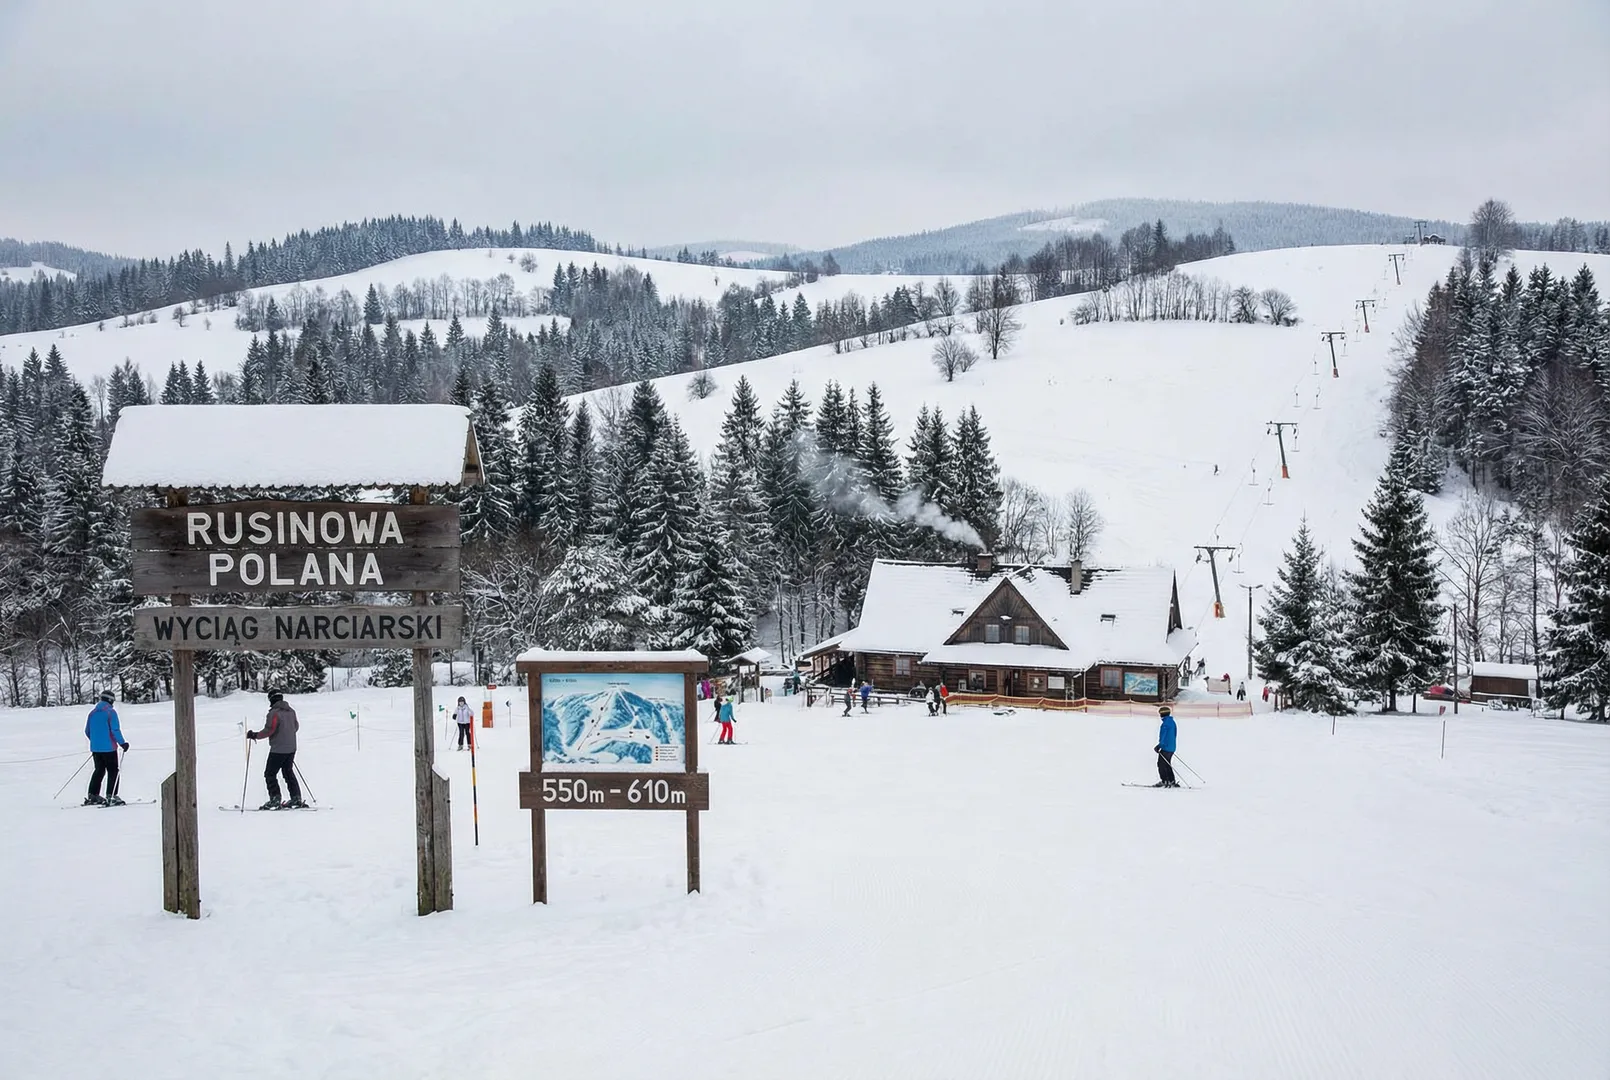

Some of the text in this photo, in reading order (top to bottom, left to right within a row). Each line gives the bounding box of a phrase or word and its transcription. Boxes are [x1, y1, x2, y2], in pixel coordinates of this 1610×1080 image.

[187, 511, 404, 545] RUSINOWA
[209, 552, 384, 586] POLANA
[153, 614, 442, 646] WYCIĄG NARCIARSKI
[542, 778, 605, 803] 550m
[627, 779, 686, 804] 610m
